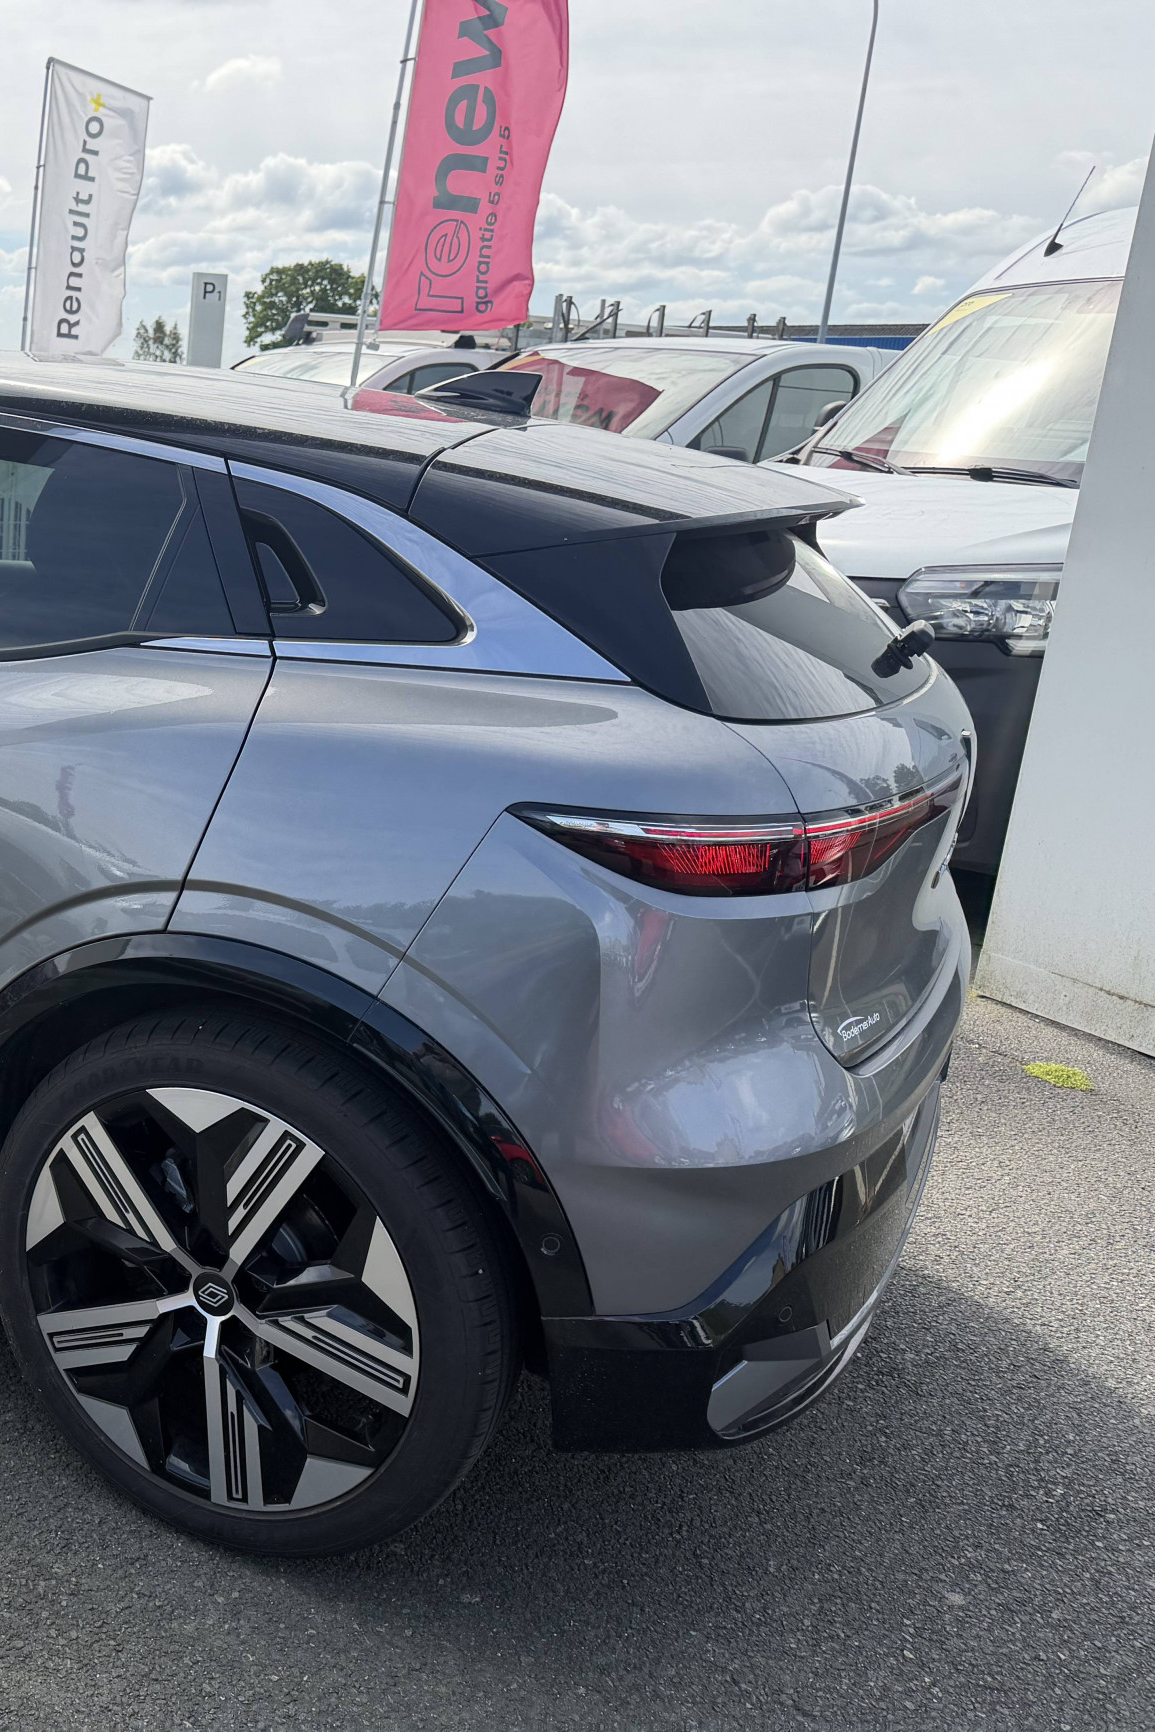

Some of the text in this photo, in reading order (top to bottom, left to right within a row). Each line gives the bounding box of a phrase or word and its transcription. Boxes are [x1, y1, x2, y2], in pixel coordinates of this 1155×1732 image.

[414, 0, 509, 314] renew
[474, 124, 512, 315] garantie 5 sur 5
[55, 191, 94, 341] Renault
